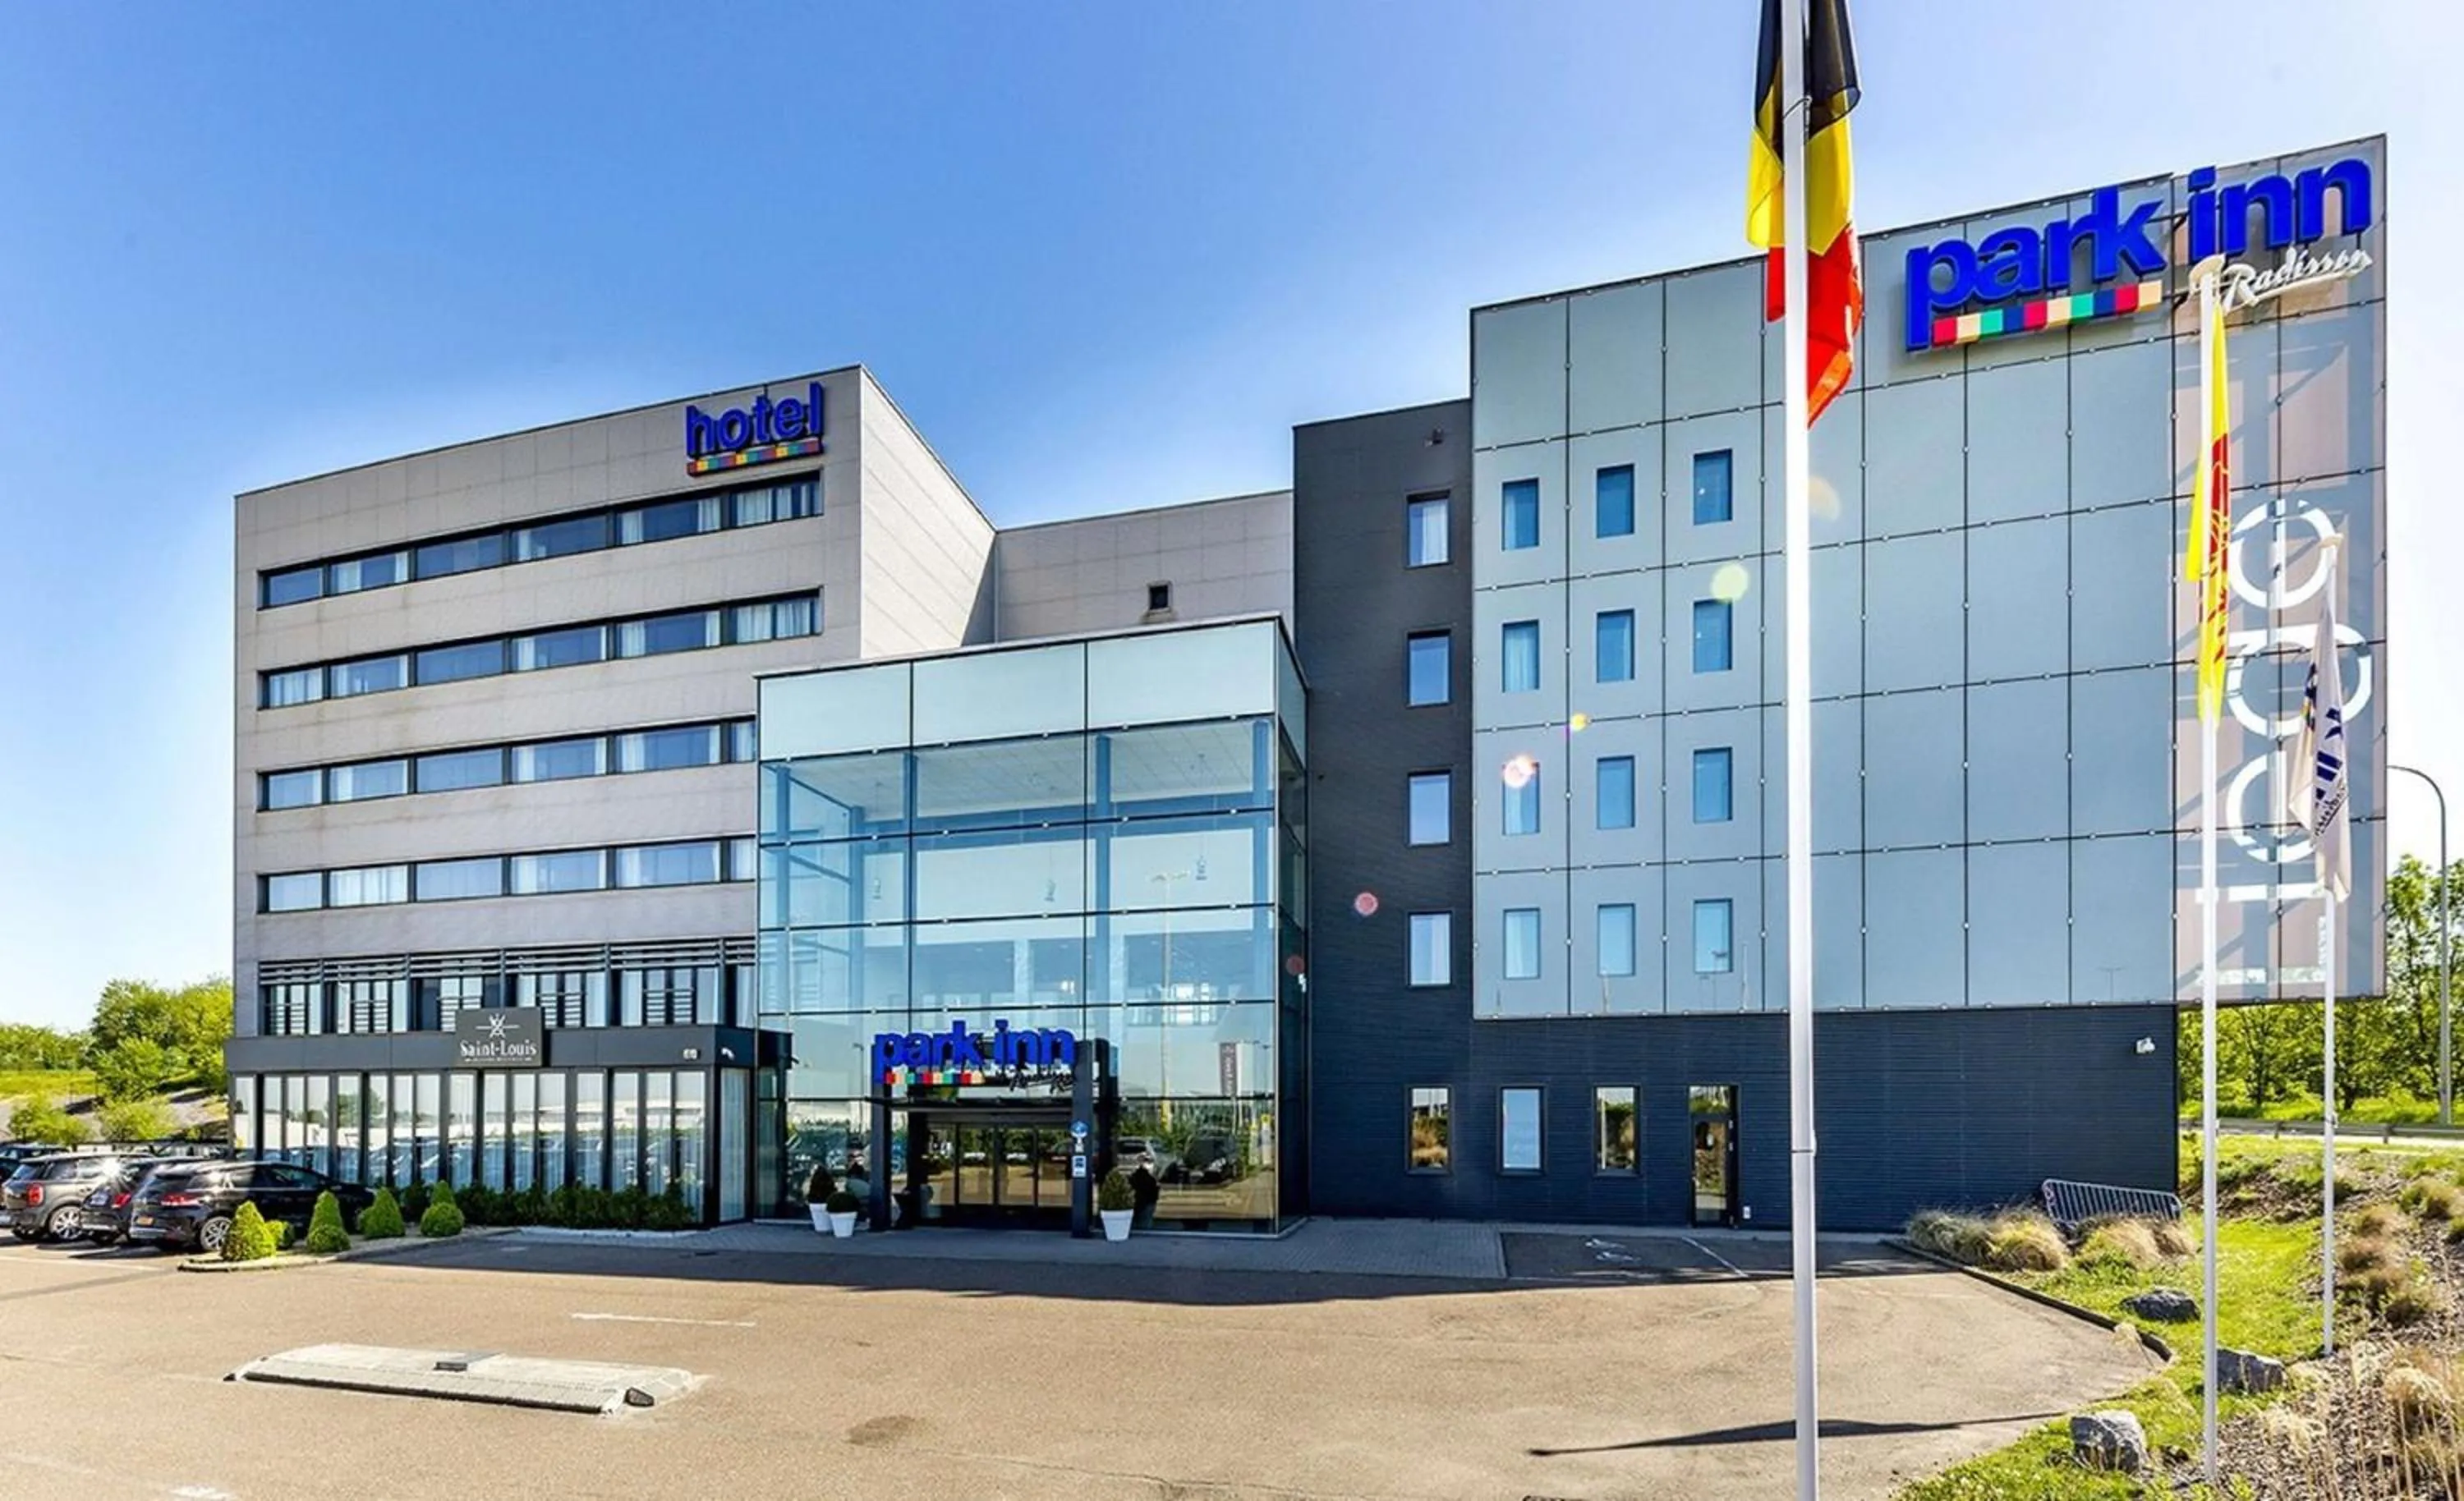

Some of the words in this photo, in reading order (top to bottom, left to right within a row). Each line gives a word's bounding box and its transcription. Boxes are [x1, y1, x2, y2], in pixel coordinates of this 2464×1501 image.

[1905, 186, 2167, 351] park
[2187, 158, 2372, 266] inn
[2222, 241, 2373, 315] Radisson
[686, 380, 825, 460] hotel
[459, 1039, 537, 1057] Saint-Louis
[871, 1020, 985, 1085] park
[992, 1018, 1076, 1066] inn
